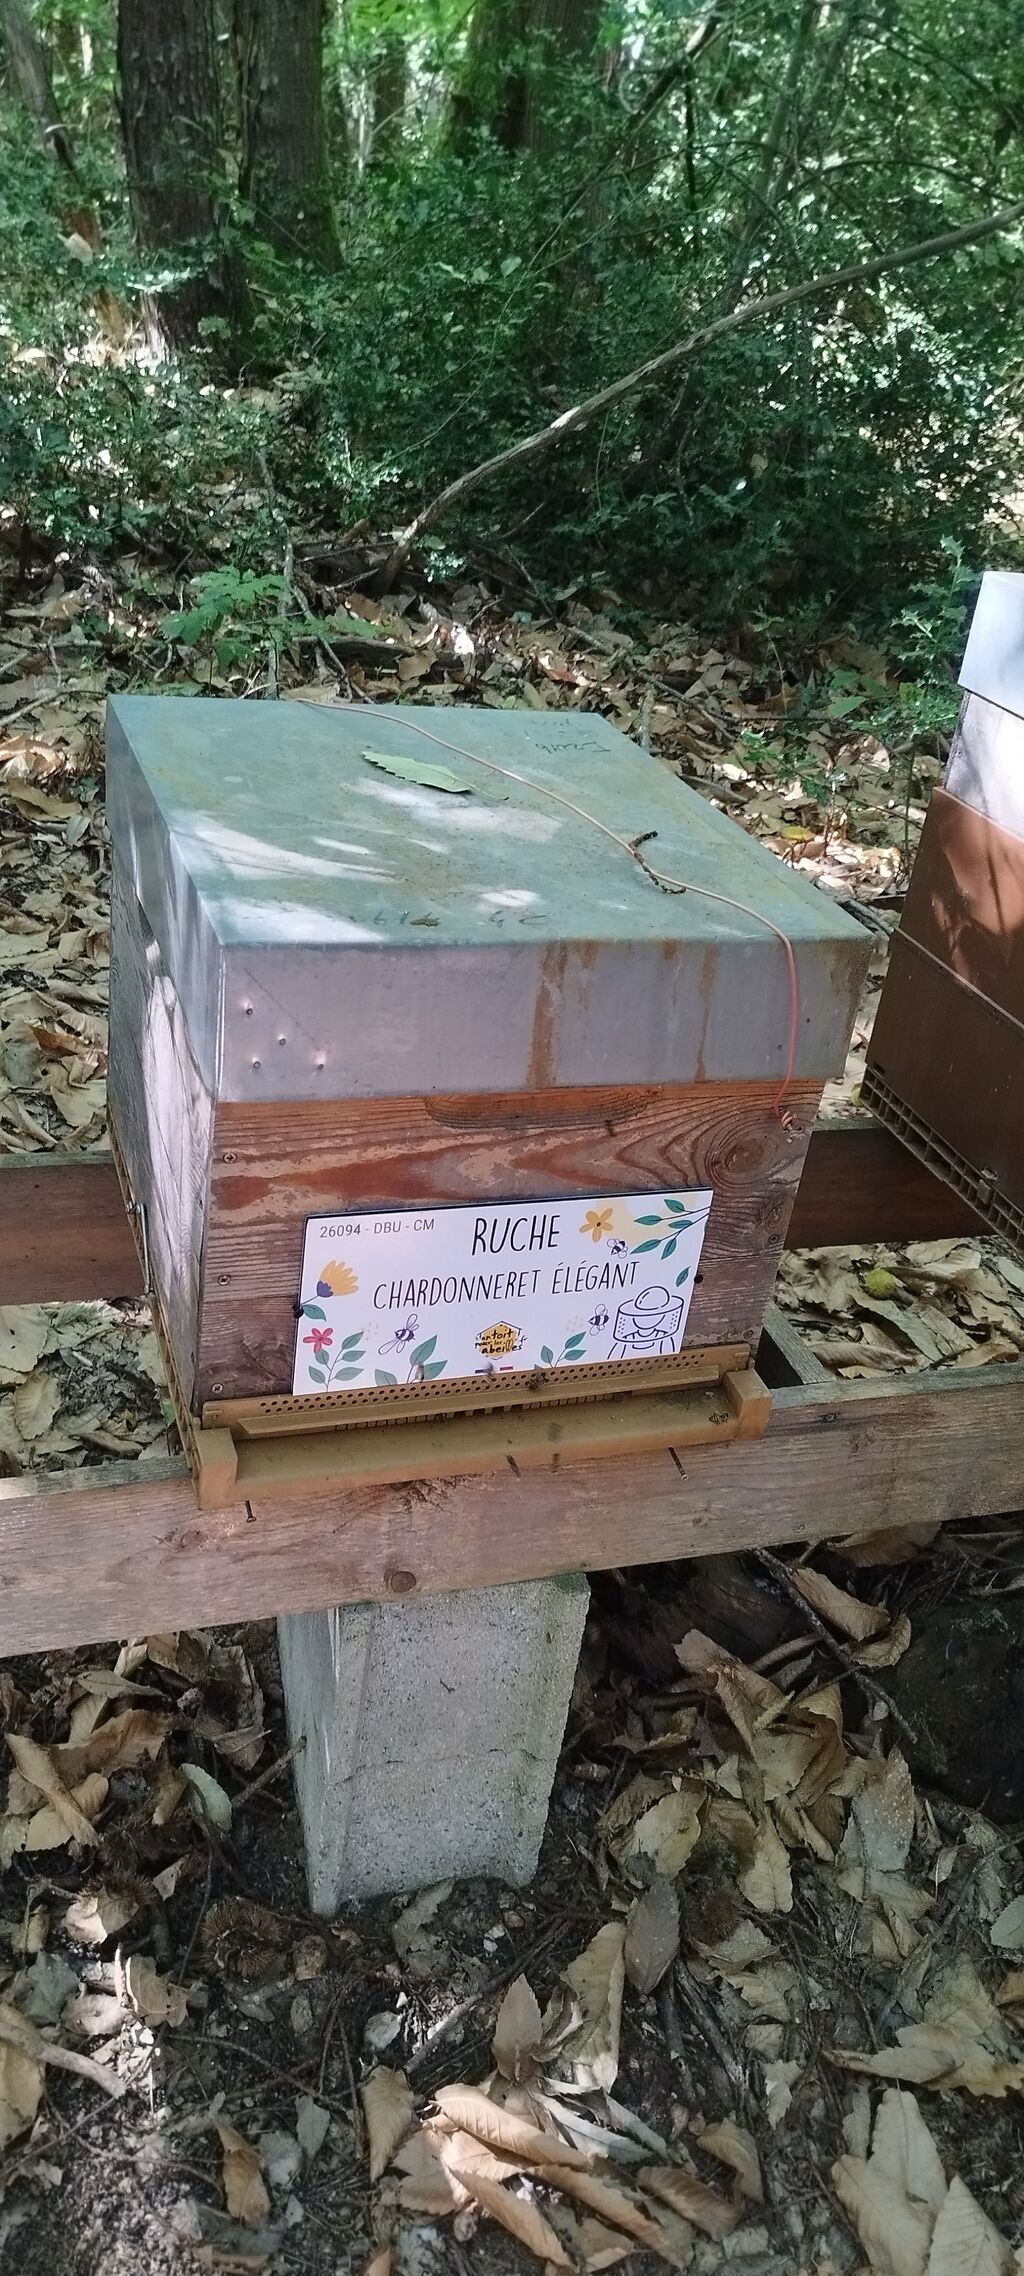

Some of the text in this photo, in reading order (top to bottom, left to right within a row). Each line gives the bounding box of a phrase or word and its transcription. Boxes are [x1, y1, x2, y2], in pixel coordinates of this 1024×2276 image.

[320, 1224, 361, 1238] 26094
[374, 1220, 402, 1234] DBU
[413, 1218, 435, 1231] CM
[471, 1214, 561, 1255] RUCHE
[373, 1260, 640, 1310] CHARDONNERET ÉLÉGANT
[491, 1328, 514, 1341] toit
[482, 1339, 523, 1354] abeilles
